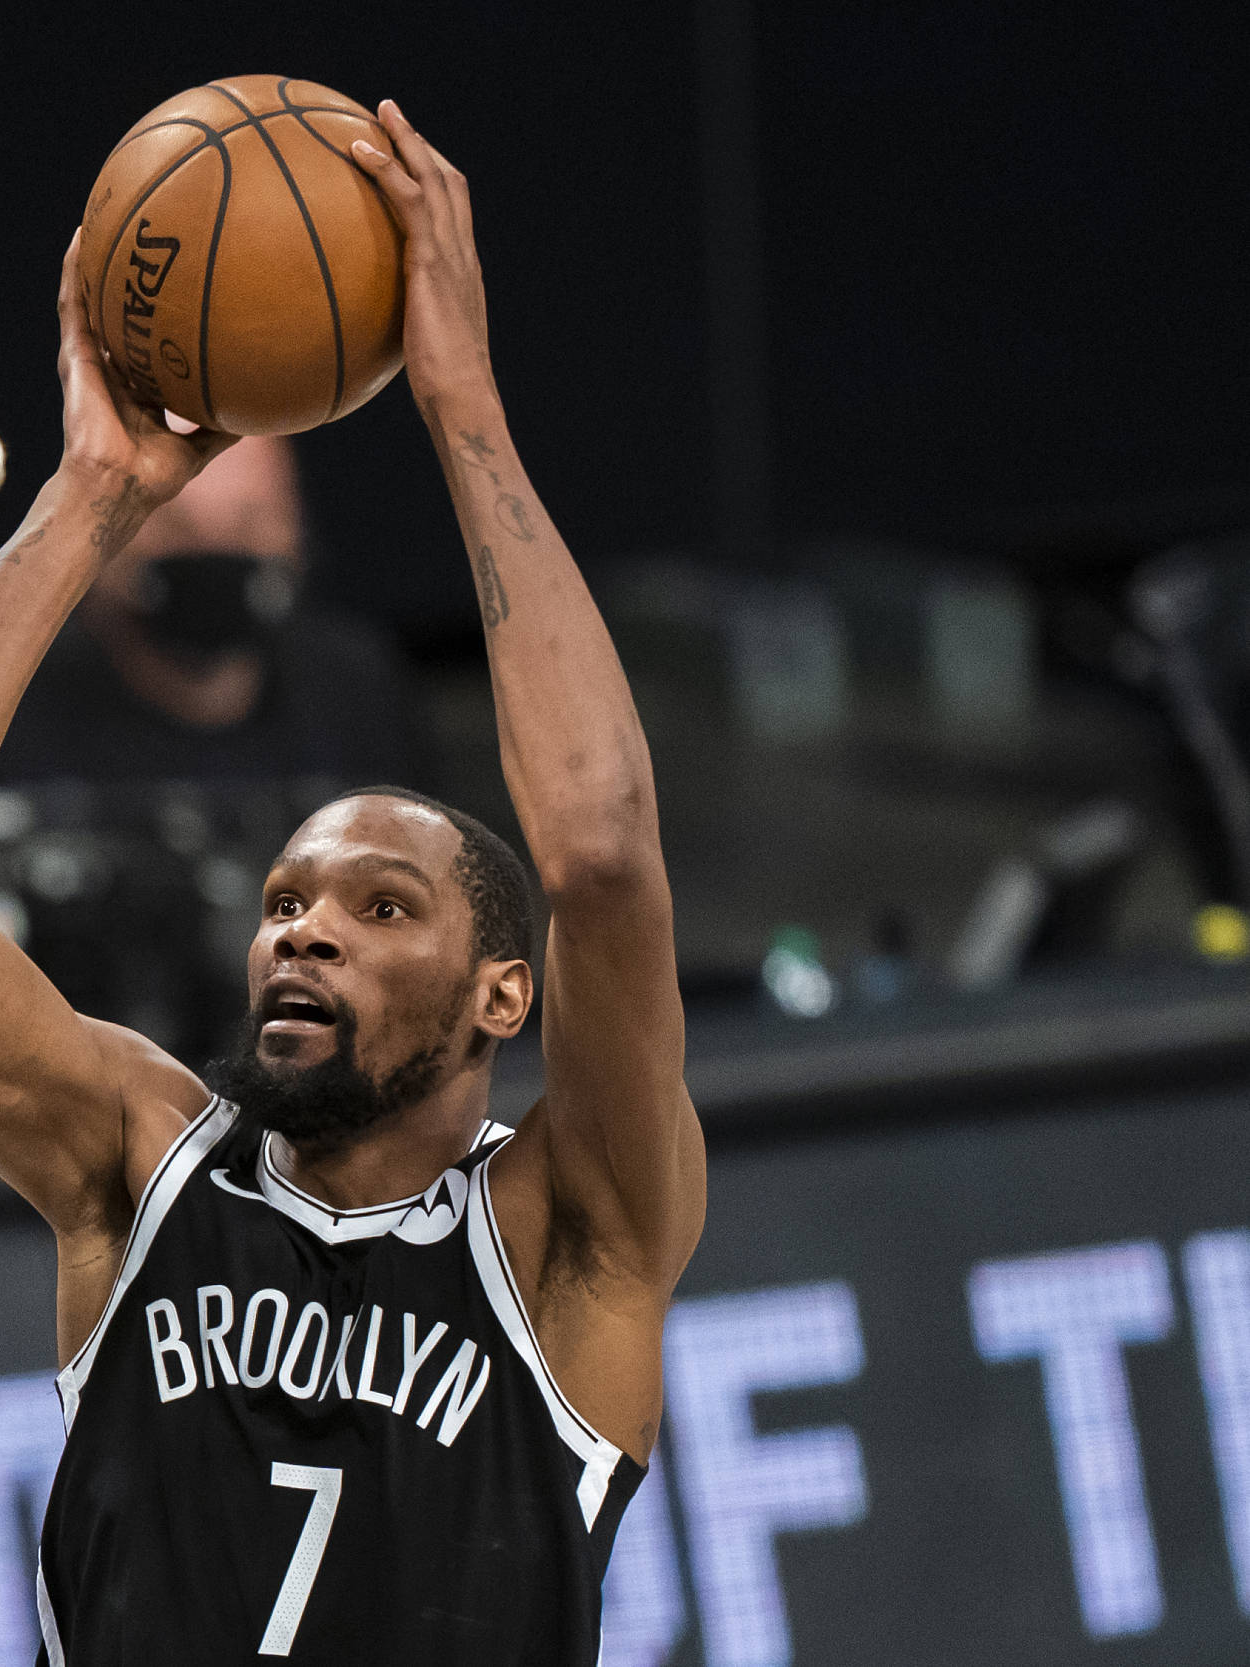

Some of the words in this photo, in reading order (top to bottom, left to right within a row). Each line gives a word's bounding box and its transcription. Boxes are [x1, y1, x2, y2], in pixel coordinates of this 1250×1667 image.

[147, 1284, 491, 1448] BROOKLYN
[258, 1462, 343, 1656] 7
[600, 1280, 868, 1666] F
